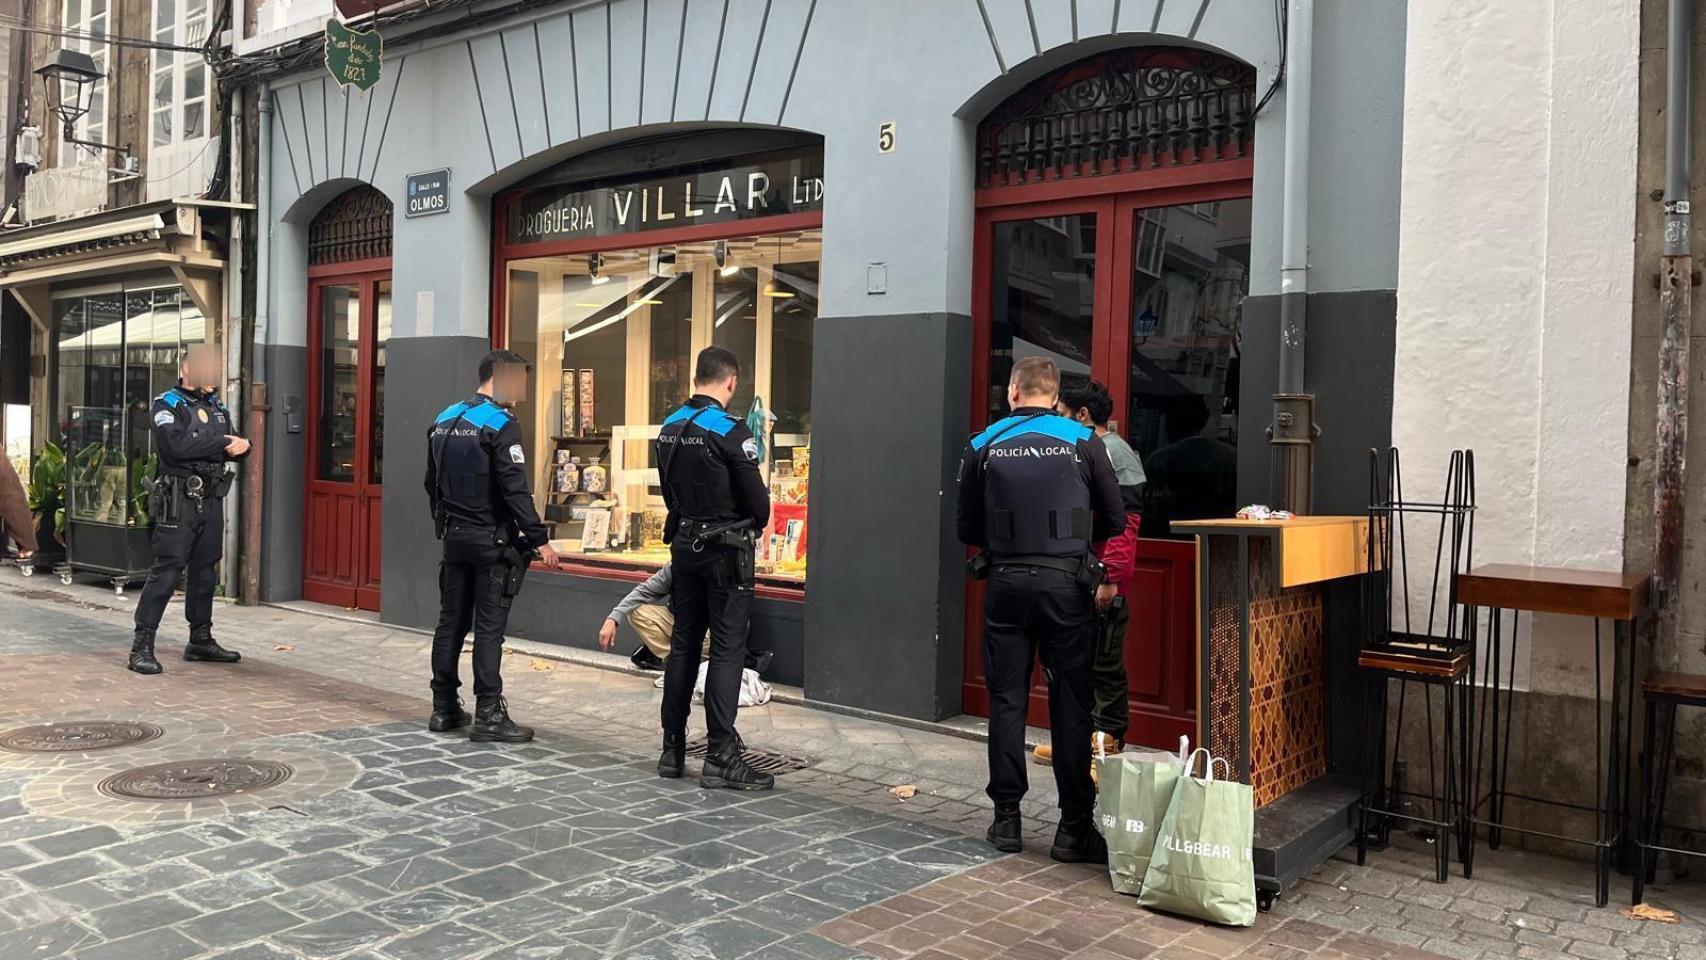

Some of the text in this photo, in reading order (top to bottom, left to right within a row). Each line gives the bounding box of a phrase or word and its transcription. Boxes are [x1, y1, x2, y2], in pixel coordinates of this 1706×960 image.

[880, 123, 894, 151] 5
[410, 194, 444, 212] OLMOS
[517, 204, 595, 237] DROGUERIA
[613, 172, 770, 225] VILLAR
[685, 436, 704, 445] LOCAL
[989, 446, 1072, 458] POLICÍA LOCAL
